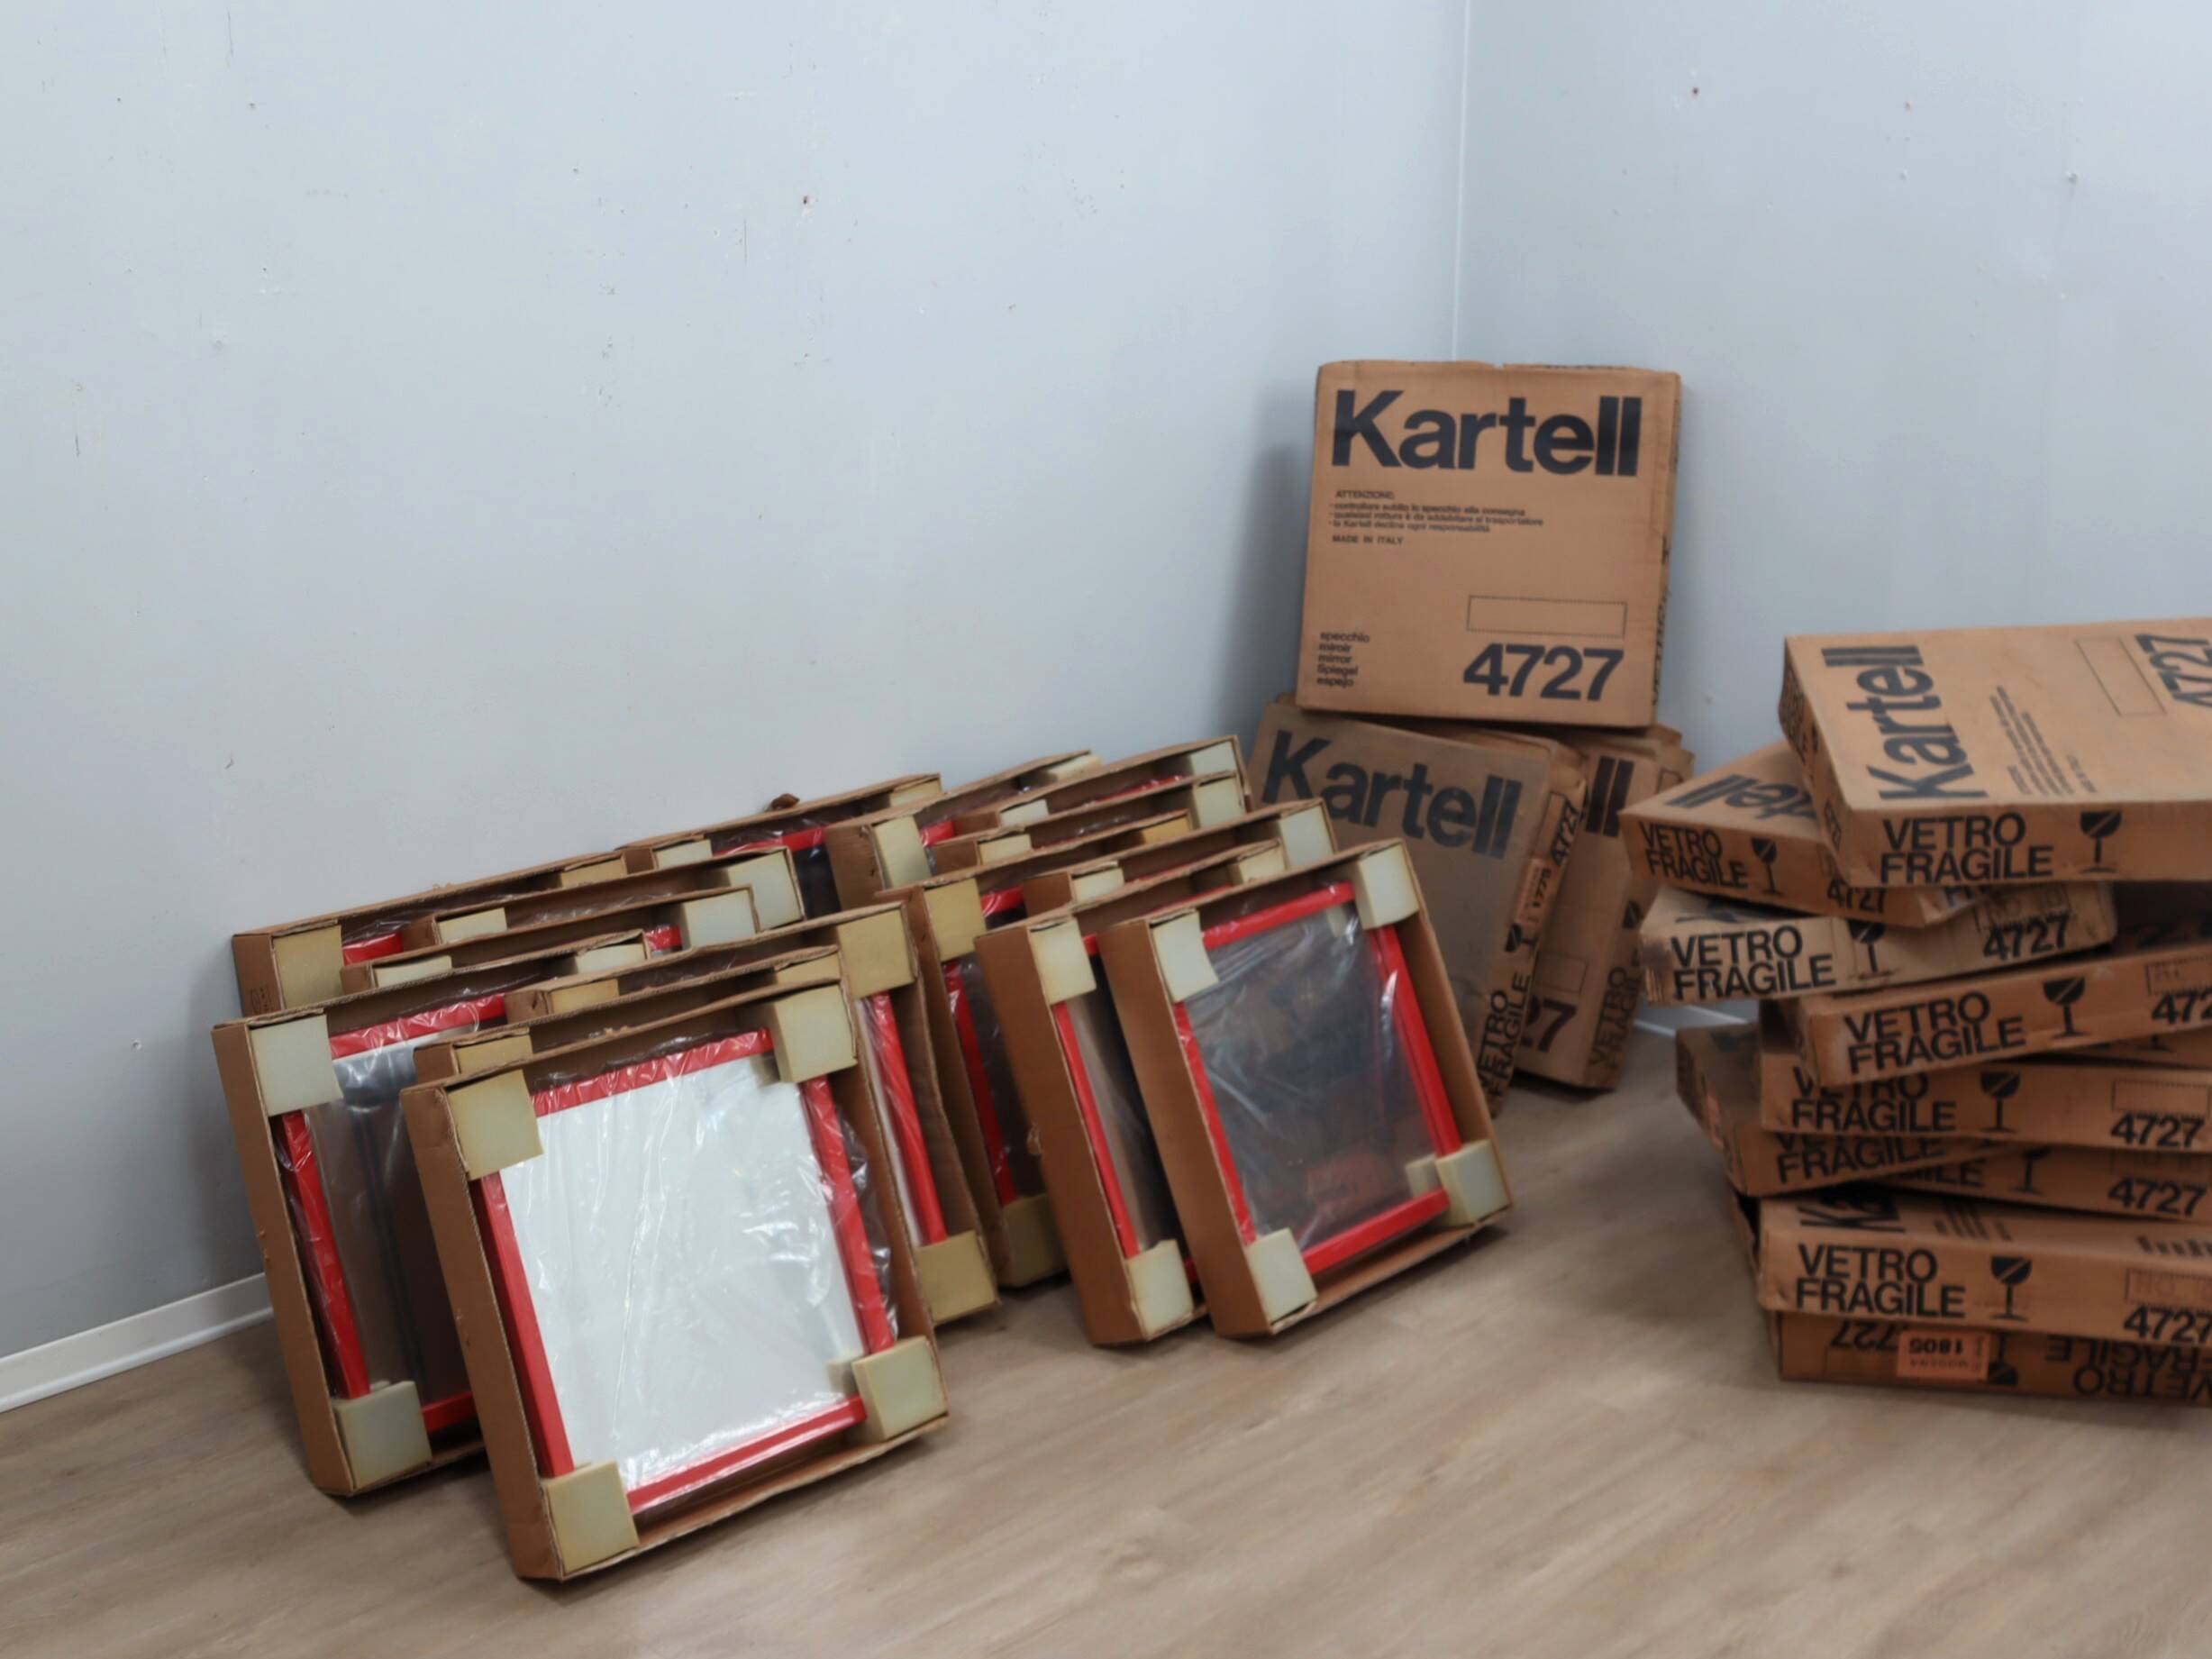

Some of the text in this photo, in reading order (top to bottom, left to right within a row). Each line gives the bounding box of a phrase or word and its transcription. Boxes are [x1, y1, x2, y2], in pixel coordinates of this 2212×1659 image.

[1332, 389, 1643, 477] Kartell
[1343, 520, 1371, 529] Kartell
[1423, 505, 1461, 515] specchio
[1482, 507, 1525, 517] consegna
[1332, 535, 1404, 545] MADE IN ITALY
[1320, 632, 1370, 643] specchio
[1317, 664, 1359, 678] Spiegel
[1318, 655, 1352, 663] mirror
[1463, 643, 1625, 702] 4727
[1316, 678, 1354, 688] espejo
[1821, 645, 1989, 800] Kartell
[1262, 729, 1524, 860] Kartell
[1550, 798, 1581, 867] 4727
[1638, 820, 1722, 858] VETRO
[1882, 812, 2026, 852] VETRO
[1646, 848, 1749, 890] FRAGILE
[1880, 845, 2056, 885] FRAGILE
[1670, 925, 1803, 971] VETRO
[1984, 912, 2071, 961] 4727
[1674, 953, 1837, 1001] FRAGILE
[1844, 992, 1990, 1044] VETRO
[2151, 990, 2212, 1025] 472
[1488, 971, 1531, 1098] FRAGILE
[1847, 1016, 2026, 1074] FRAGILE
[1792, 1099, 1957, 1134] FRAGILE
[2110, 1112, 2206, 1150] 4727
[1776, 1136, 1947, 1185] FRAGILE
[2107, 1177, 2207, 1218] 4727
[1798, 1244, 1938, 1284] VETRO
[1797, 1277, 1966, 1319] FRAGILE
[2124, 1305, 2212, 1344] 4727
[2074, 1364, 2212, 1402] VETRO
